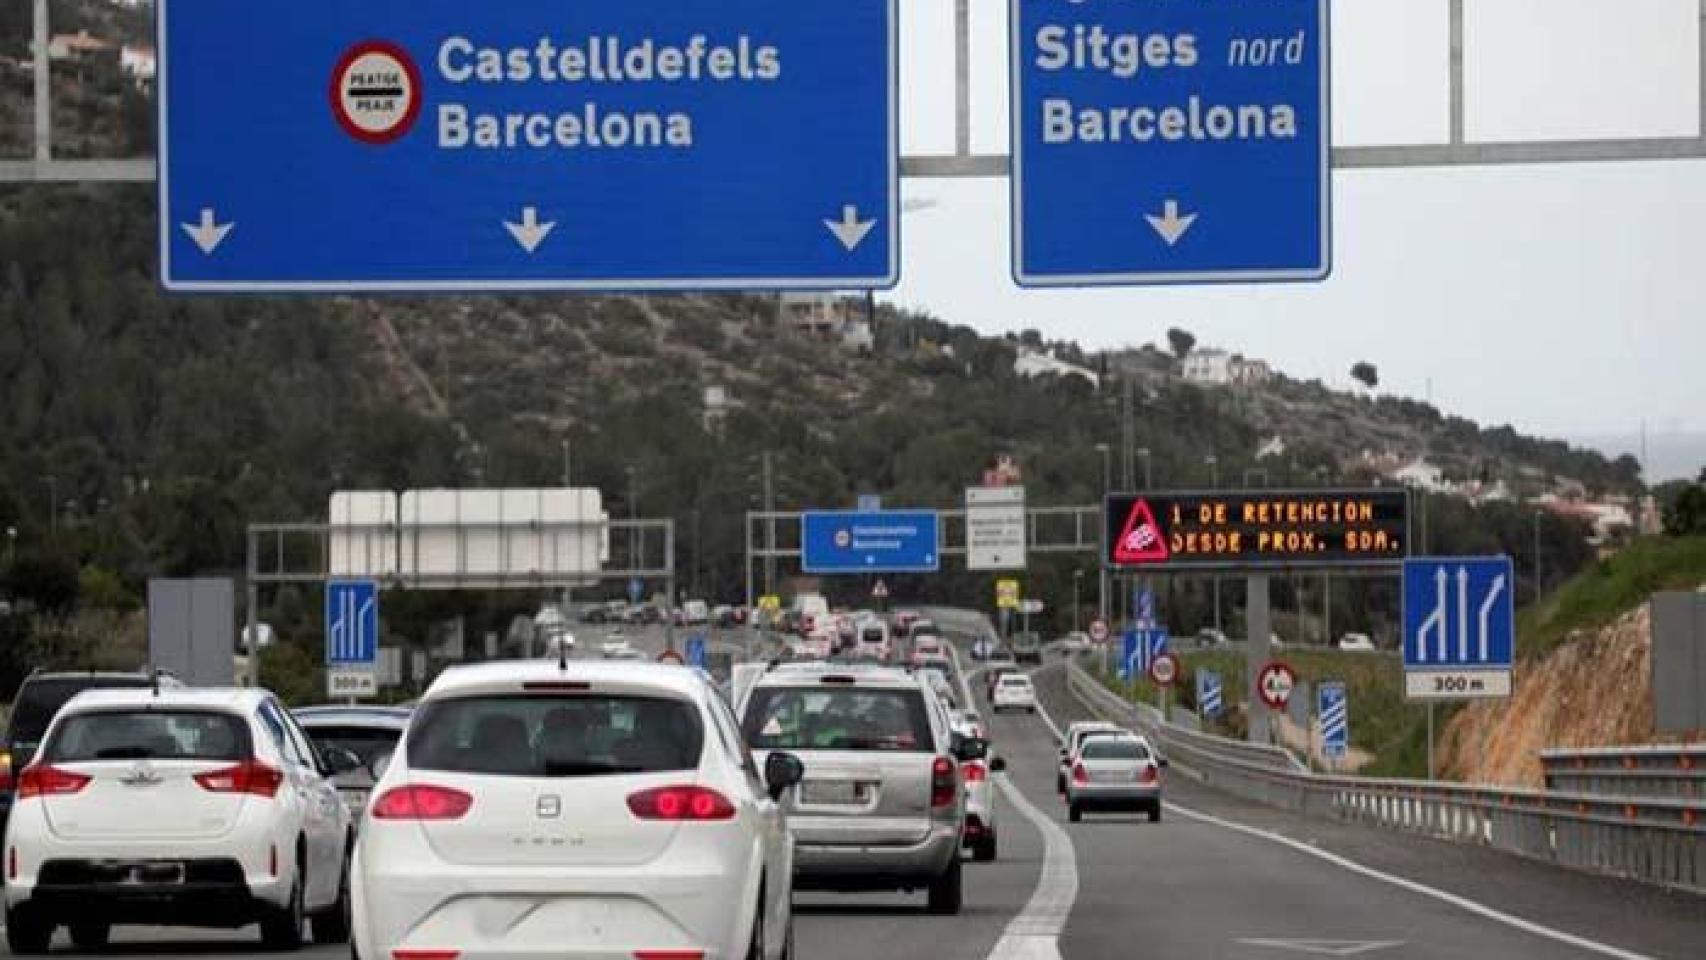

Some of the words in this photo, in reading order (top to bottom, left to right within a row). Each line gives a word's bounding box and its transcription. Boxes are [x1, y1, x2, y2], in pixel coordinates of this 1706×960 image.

[438, 36, 781, 81] Castelldefels
[1036, 25, 1198, 77] Sitges
[1229, 30, 1305, 66] nord
[437, 104, 692, 147] Barcelona
[1042, 96, 1296, 142] Barcelona
[1200, 503, 1226, 524] DE
[1244, 502, 1372, 522] RETENCION
[1172, 532, 1240, 553] DESDE
[1259, 531, 1325, 552] PROX.
[1435, 676, 1468, 691] 300
[1470, 679, 1484, 690] m
